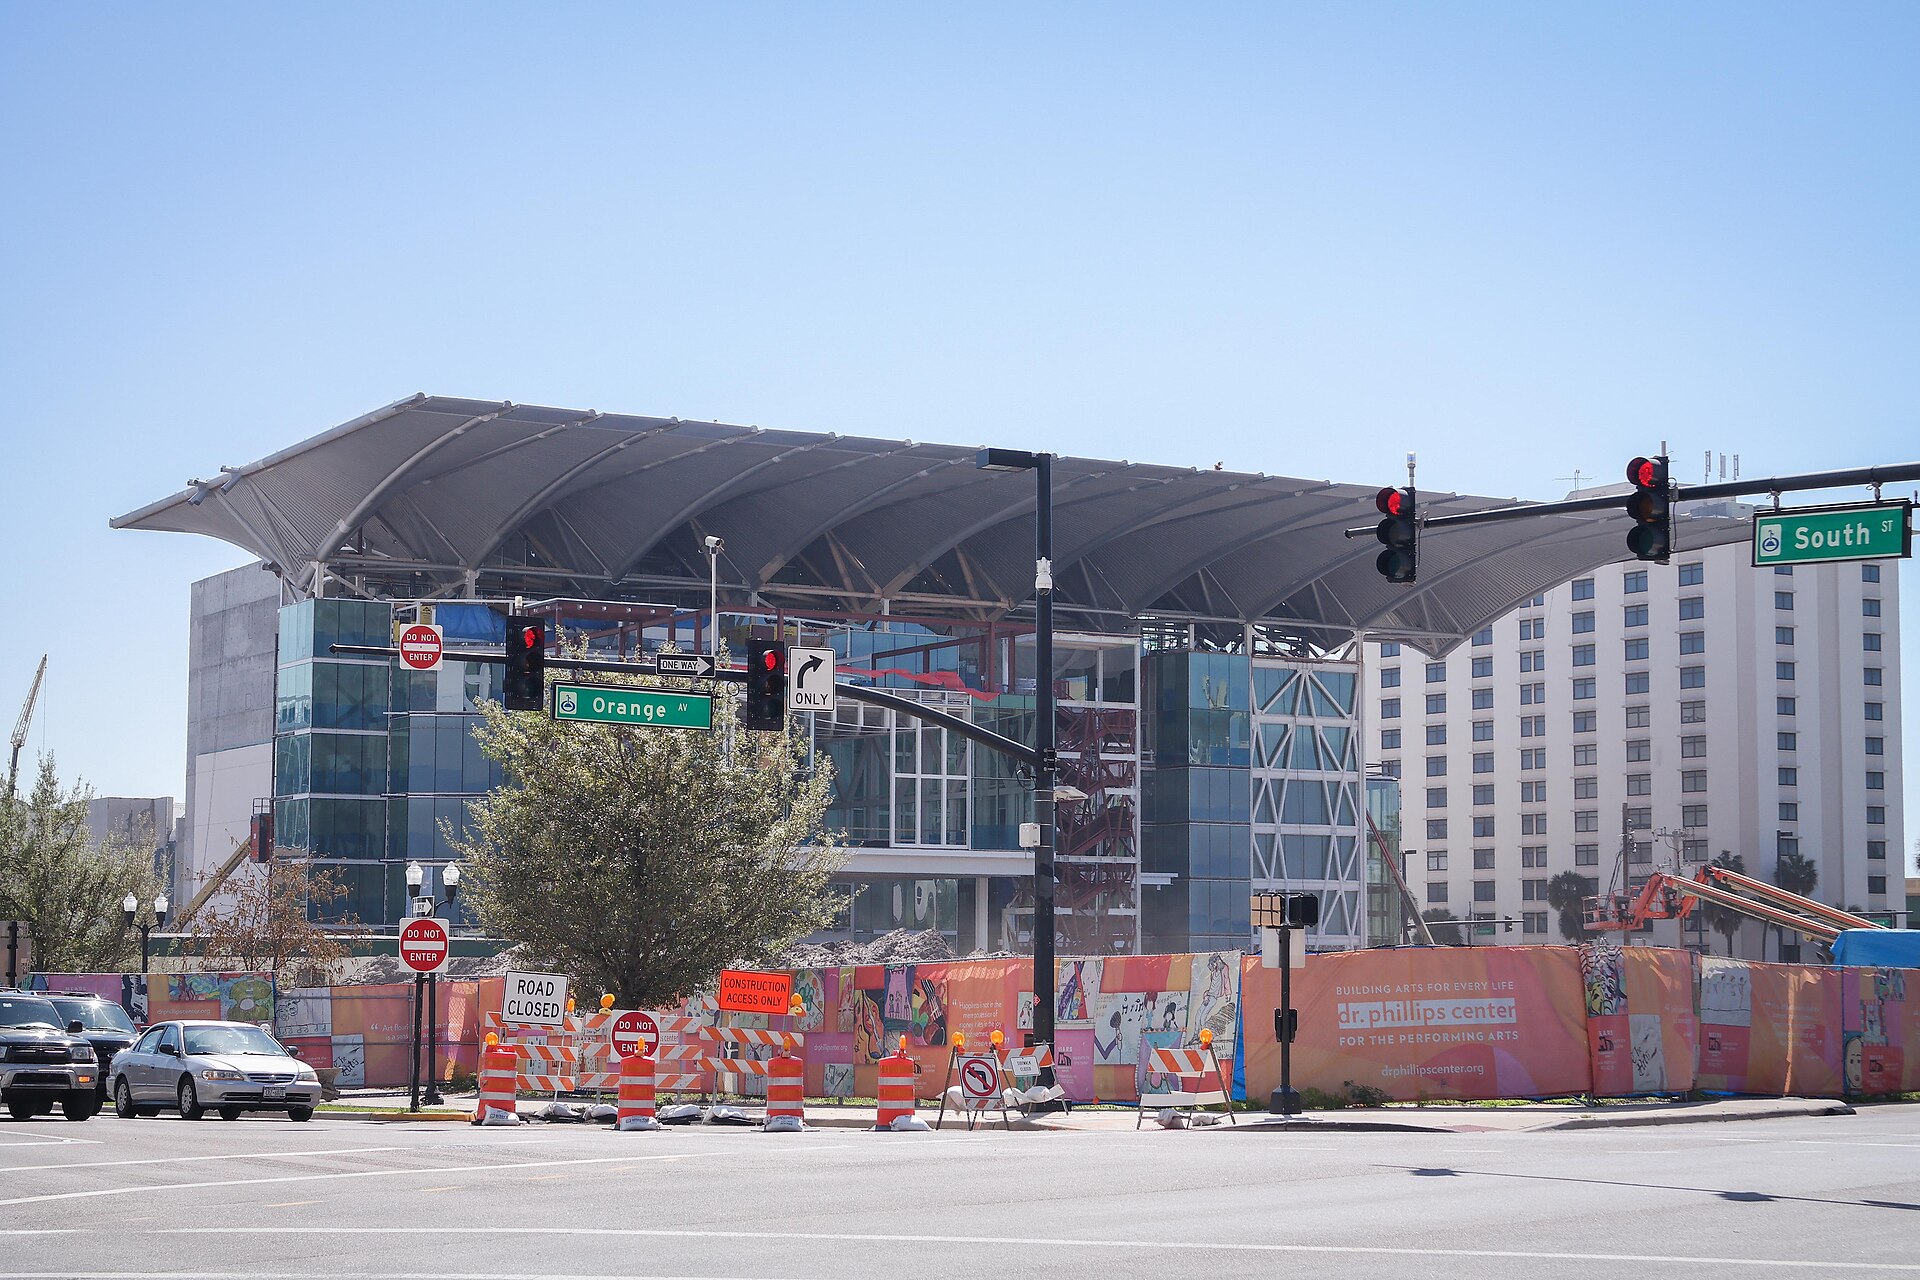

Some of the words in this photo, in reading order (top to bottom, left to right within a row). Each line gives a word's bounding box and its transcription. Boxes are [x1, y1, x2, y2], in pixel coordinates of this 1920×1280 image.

[1794, 523, 1870, 550] South
[1881, 520, 1893, 533] ST
[406, 633, 417, 641] DO
[421, 634, 436, 642] NOT
[409, 653, 433, 661] ENTER
[662, 659, 679, 669] ONE
[681, 660, 698, 670] WAY
[795, 692, 828, 706] ONLY
[592, 697, 666, 722] Orange
[678, 703, 688, 712] AV
[407, 929, 419, 938] DO
[423, 930, 440, 939] NOT
[410, 952, 437, 962] ENTER
[517, 979, 554, 997] ROAD
[723, 977, 787, 992] CONSTRUCTION
[1336, 984, 1391, 996] BUILDING
[1395, 983, 1423, 993] ARTS
[1427, 983, 1450, 992] FOR
[1454, 982, 1487, 991] EVERY
[1491, 981, 1514, 990] LIFE
[726, 993, 758, 1005] ACCESS
[760, 995, 782, 1007] ONLY
[507, 1000, 560, 1018] CLOSED
[1338, 1003, 1364, 1024] dr.
[1369, 1001, 1446, 1029] phillips
[1451, 1002, 1517, 1020] center
[619, 1021, 631, 1029] DO
[636, 1021, 652, 1031] NOT
[1339, 1036, 1365, 1046] FOR
[1369, 1035, 1394, 1045] THE
[1399, 1032, 1484, 1044] PERFORMING
[1488, 1031, 1519, 1041] ARTS
[621, 1043, 649, 1053] ENTR
[1381, 1064, 1485, 1078] drphillipscenter.org
